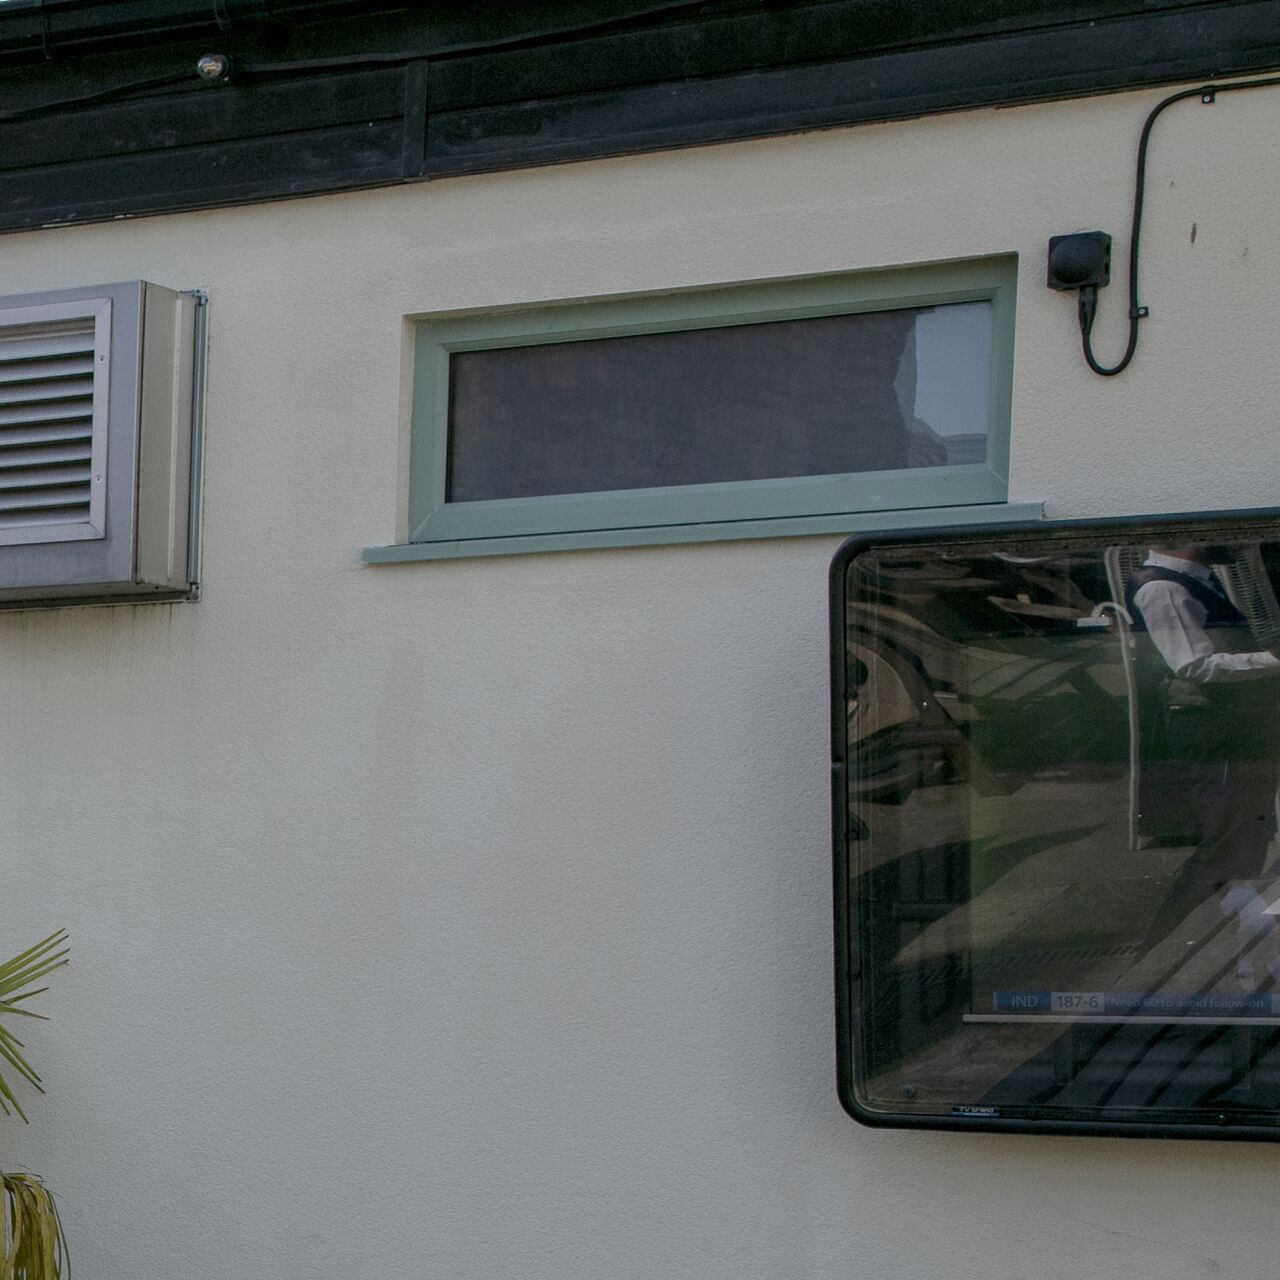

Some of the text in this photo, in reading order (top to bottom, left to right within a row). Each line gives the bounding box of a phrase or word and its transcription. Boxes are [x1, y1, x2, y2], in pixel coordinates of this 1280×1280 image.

[1011, 996, 1039, 1008] IND
[1056, 996, 1098, 1008] 187-6
[1160, 999, 1173, 1008] to
[1176, 998, 1207, 1008] avoid
[1209, 998, 1265, 1009] follow-on
